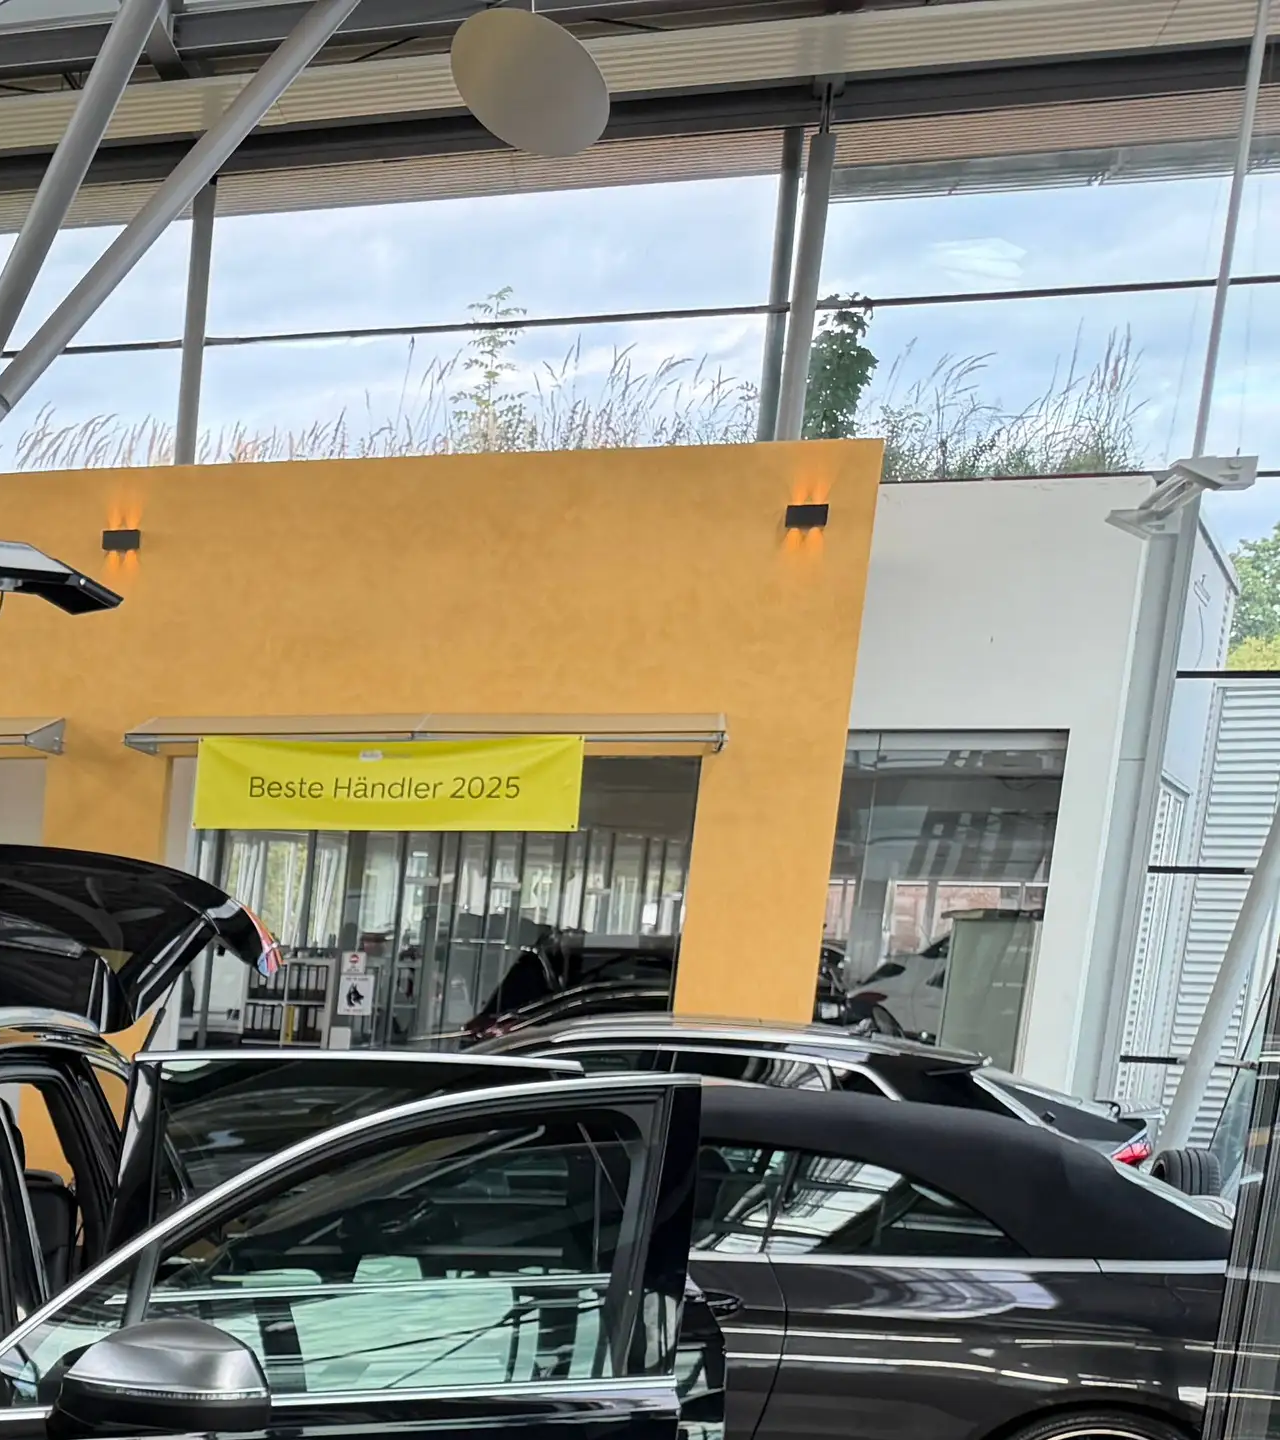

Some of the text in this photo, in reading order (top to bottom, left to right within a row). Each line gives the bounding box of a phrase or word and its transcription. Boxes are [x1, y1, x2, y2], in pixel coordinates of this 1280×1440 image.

[249, 775, 520, 800] Beste Händler 2025
